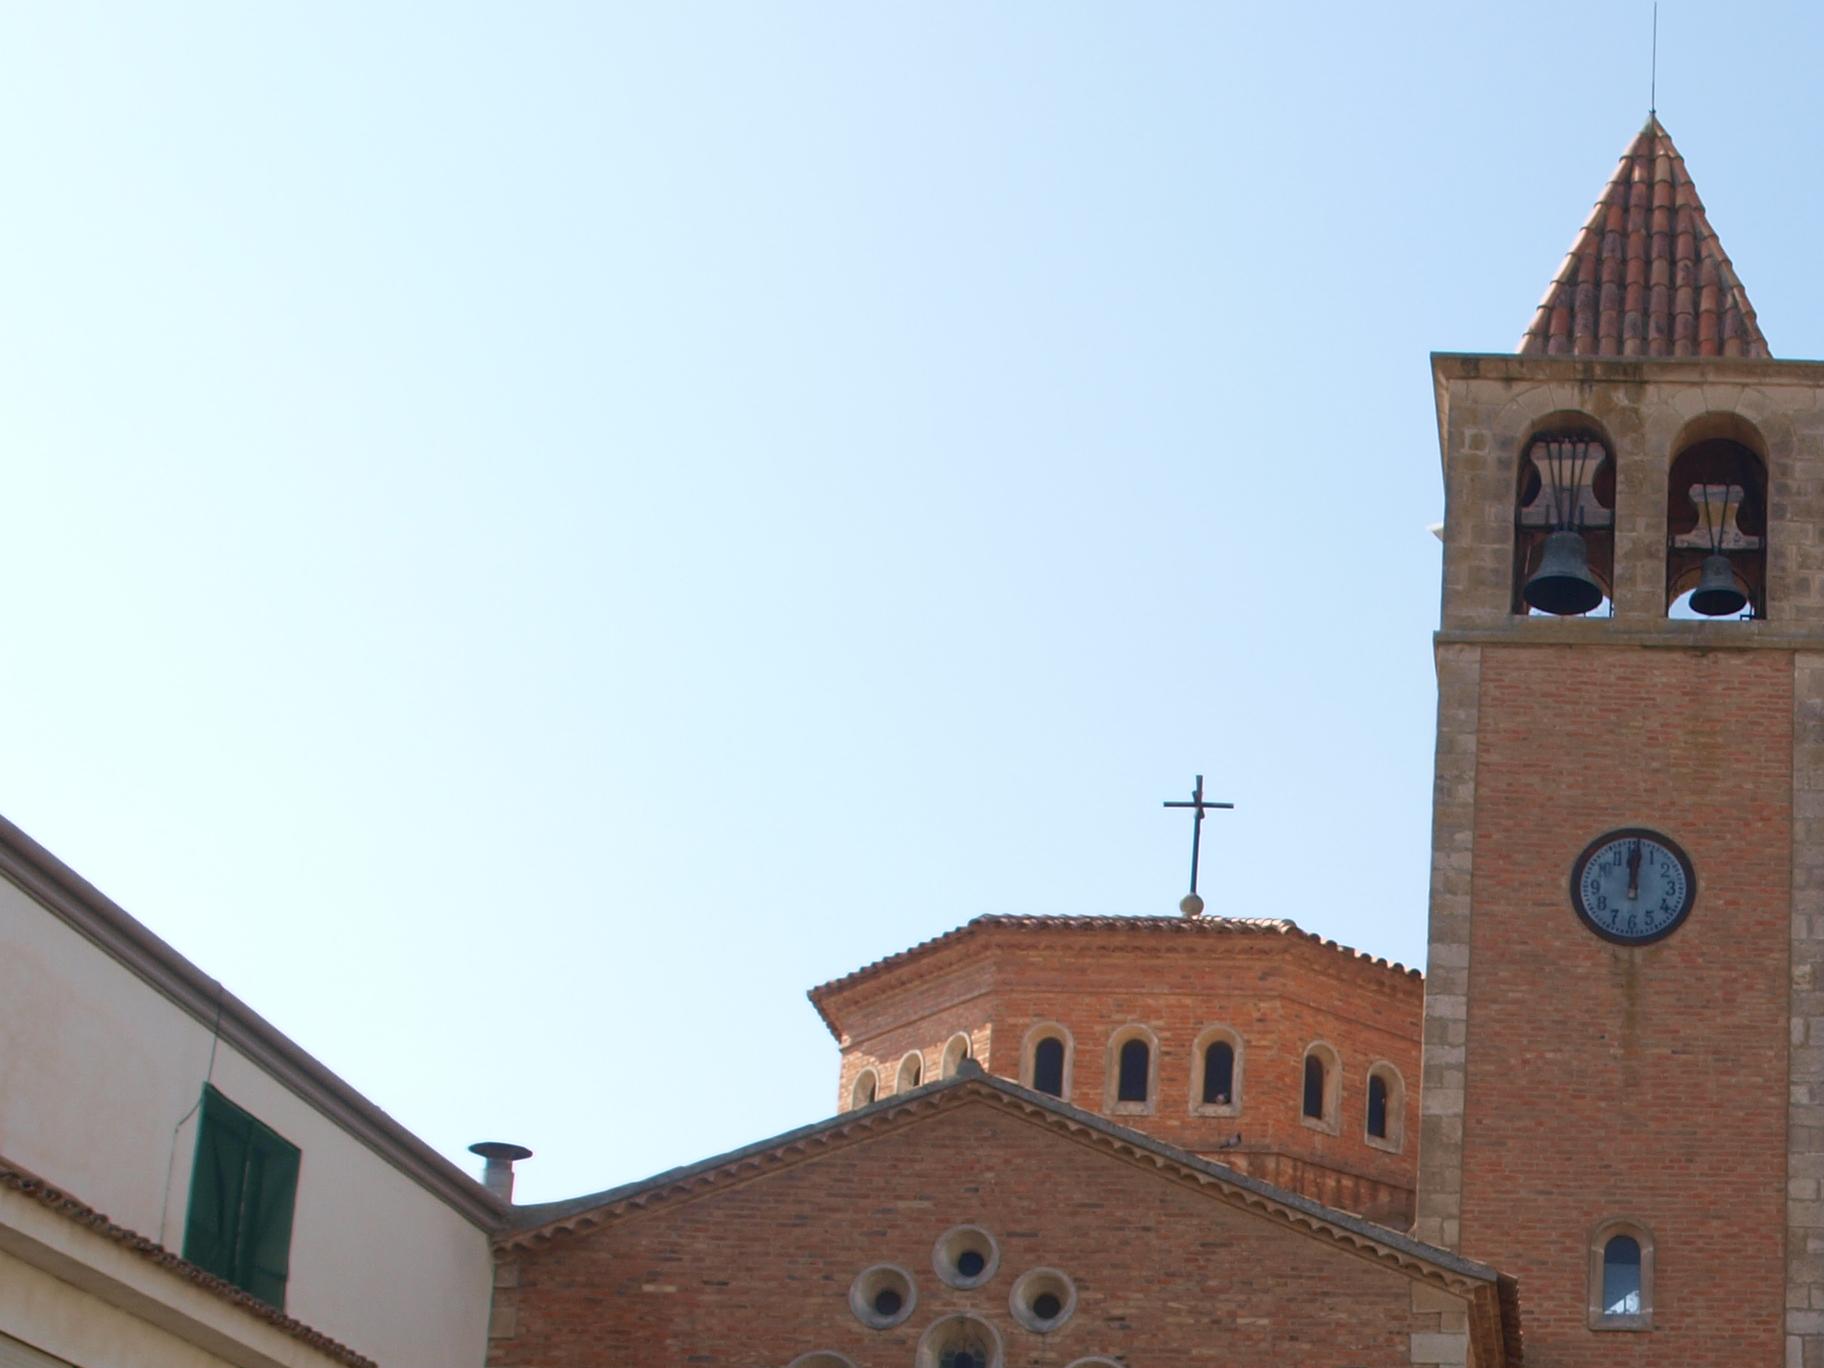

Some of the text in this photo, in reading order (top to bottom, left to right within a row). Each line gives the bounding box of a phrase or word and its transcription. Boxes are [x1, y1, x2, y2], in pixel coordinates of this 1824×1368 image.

[1613, 850, 1622, 866] 11
[1649, 850, 1655, 866] 1
[1661, 862, 1670, 879] 2
[1590, 880, 1600, 895] 9
[1666, 881, 1676, 896] 3
[1597, 895, 1607, 911] 8
[1660, 898, 1671, 912] 4
[1610, 909, 1619, 925] 7
[1627, 915, 1637, 930] 6
[1644, 910, 1654, 926] 5
